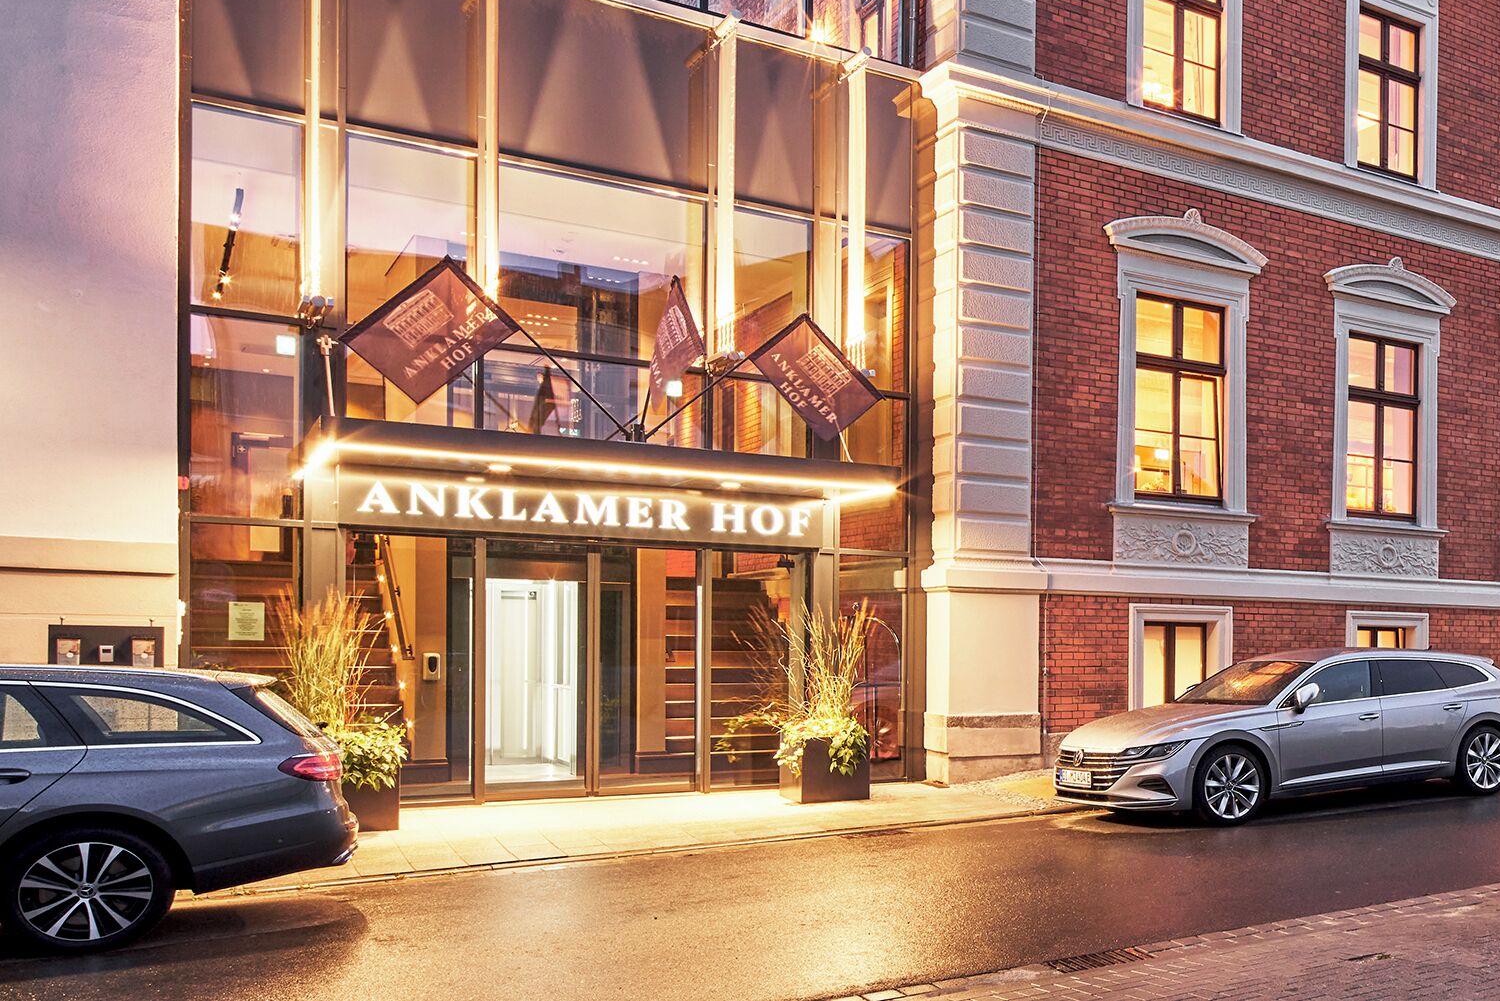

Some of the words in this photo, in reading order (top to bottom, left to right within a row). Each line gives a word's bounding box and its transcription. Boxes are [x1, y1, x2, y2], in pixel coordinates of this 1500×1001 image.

[403, 309, 492, 379] ANKLAMER
[440, 342, 474, 370] HOF
[771, 352, 838, 424] ANKLAMER
[780, 381, 808, 408] HOF
[356, 479, 690, 532] ANKLAMER
[710, 502, 813, 537] HOF
